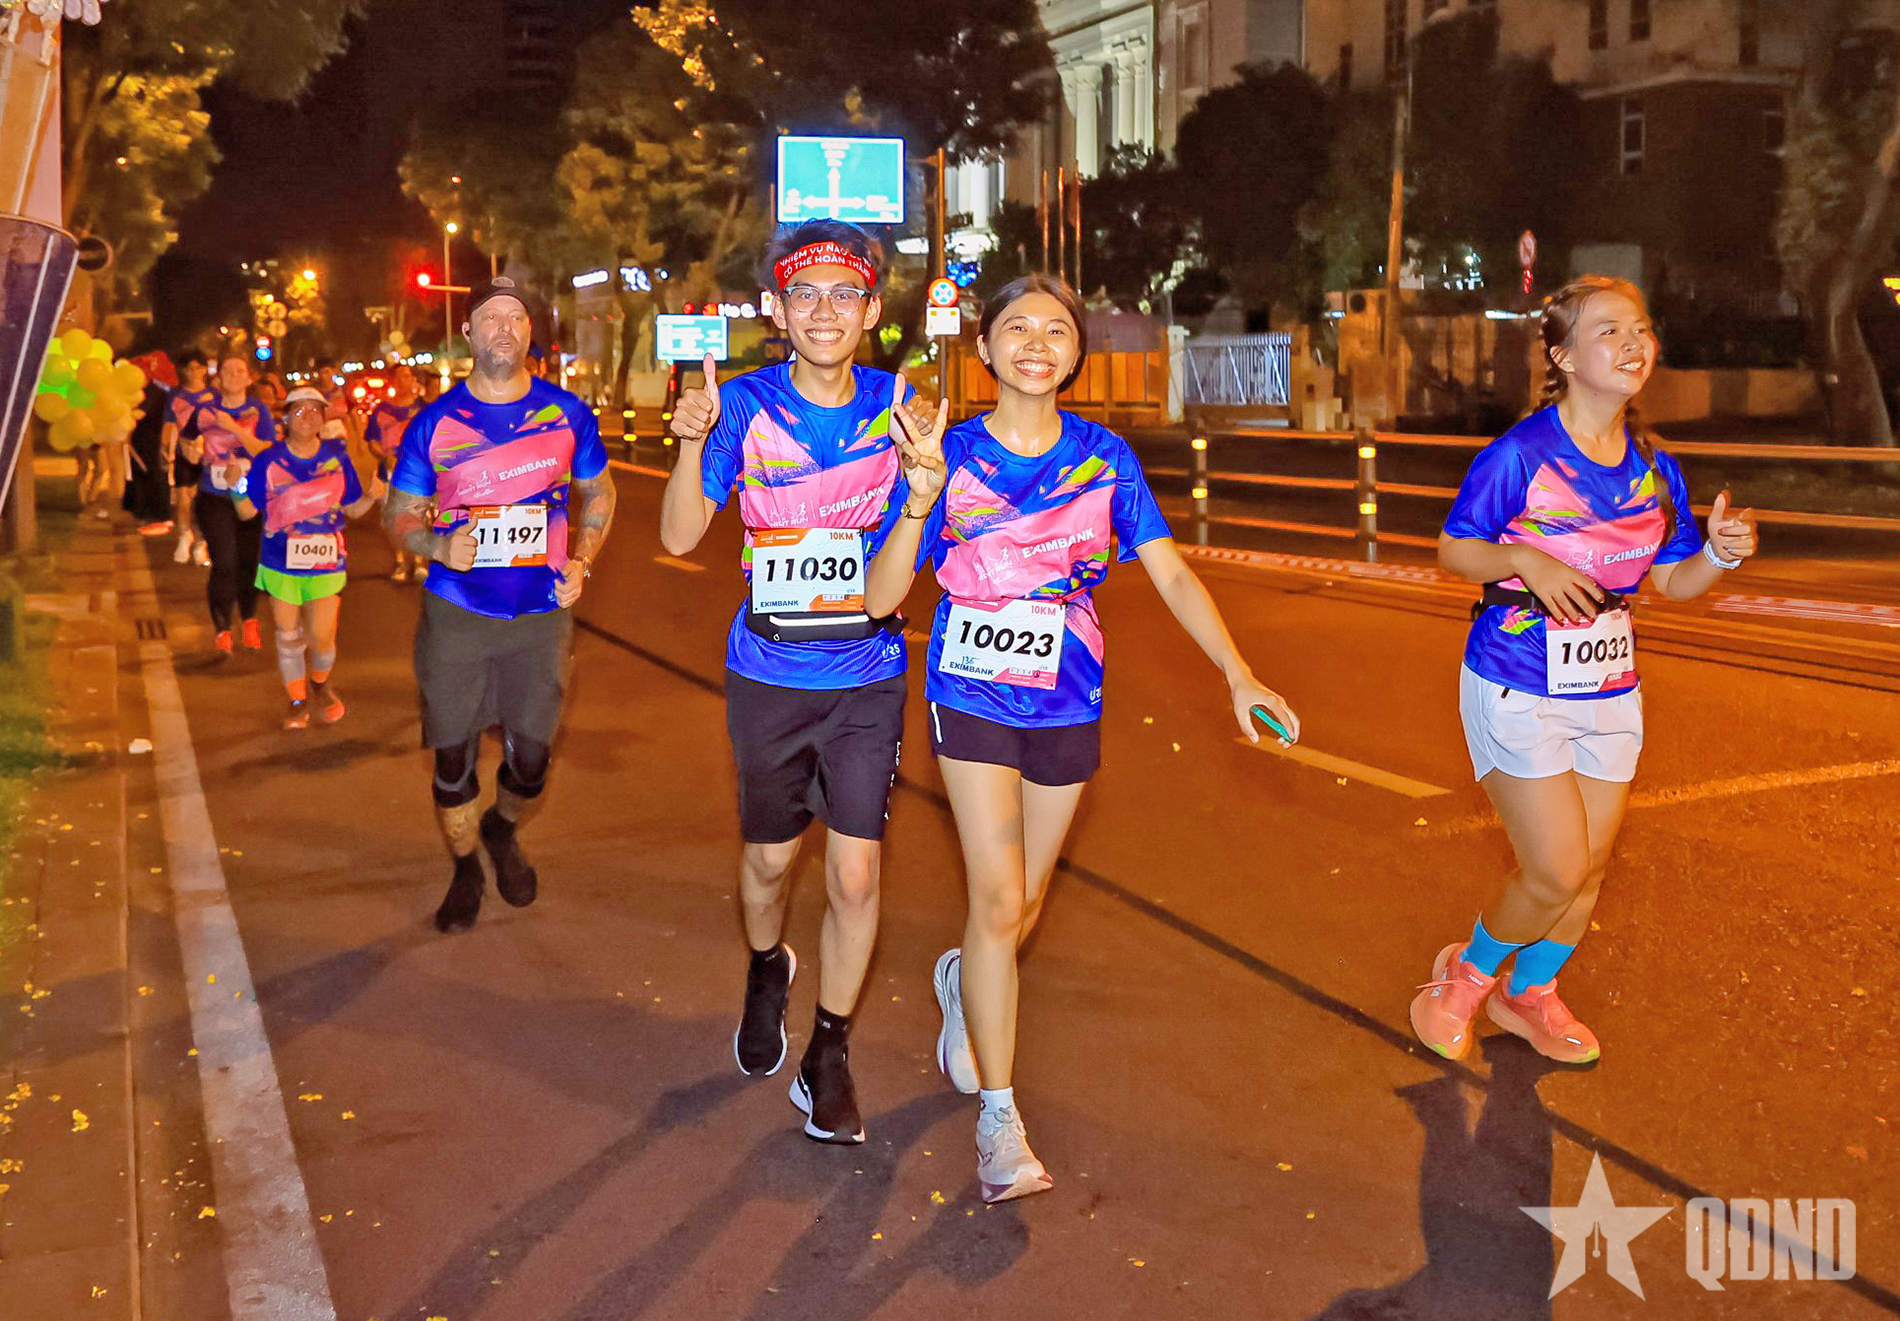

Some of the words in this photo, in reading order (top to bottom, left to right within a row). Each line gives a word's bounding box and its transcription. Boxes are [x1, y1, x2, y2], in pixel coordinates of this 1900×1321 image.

[815, 253, 845, 264] HOÀN
[498, 457, 558, 481] EXIMBANK
[818, 487, 885, 517] EXIMBANK
[479, 526, 544, 545] 11497
[829, 531, 854, 541] 10KM
[1021, 528, 1095, 558] EXIMBANK
[294, 543, 333, 556] 10401
[766, 556, 858, 582] 11030
[760, 599, 799, 608] EXIMBANK
[1031, 604, 1057, 617] 10KM
[959, 620, 1055, 658] 10023
[1561, 635, 1629, 665] 10032
[949, 661, 995, 677] EXIMBANK
[1557, 680, 1600, 690] EXIMBANK
